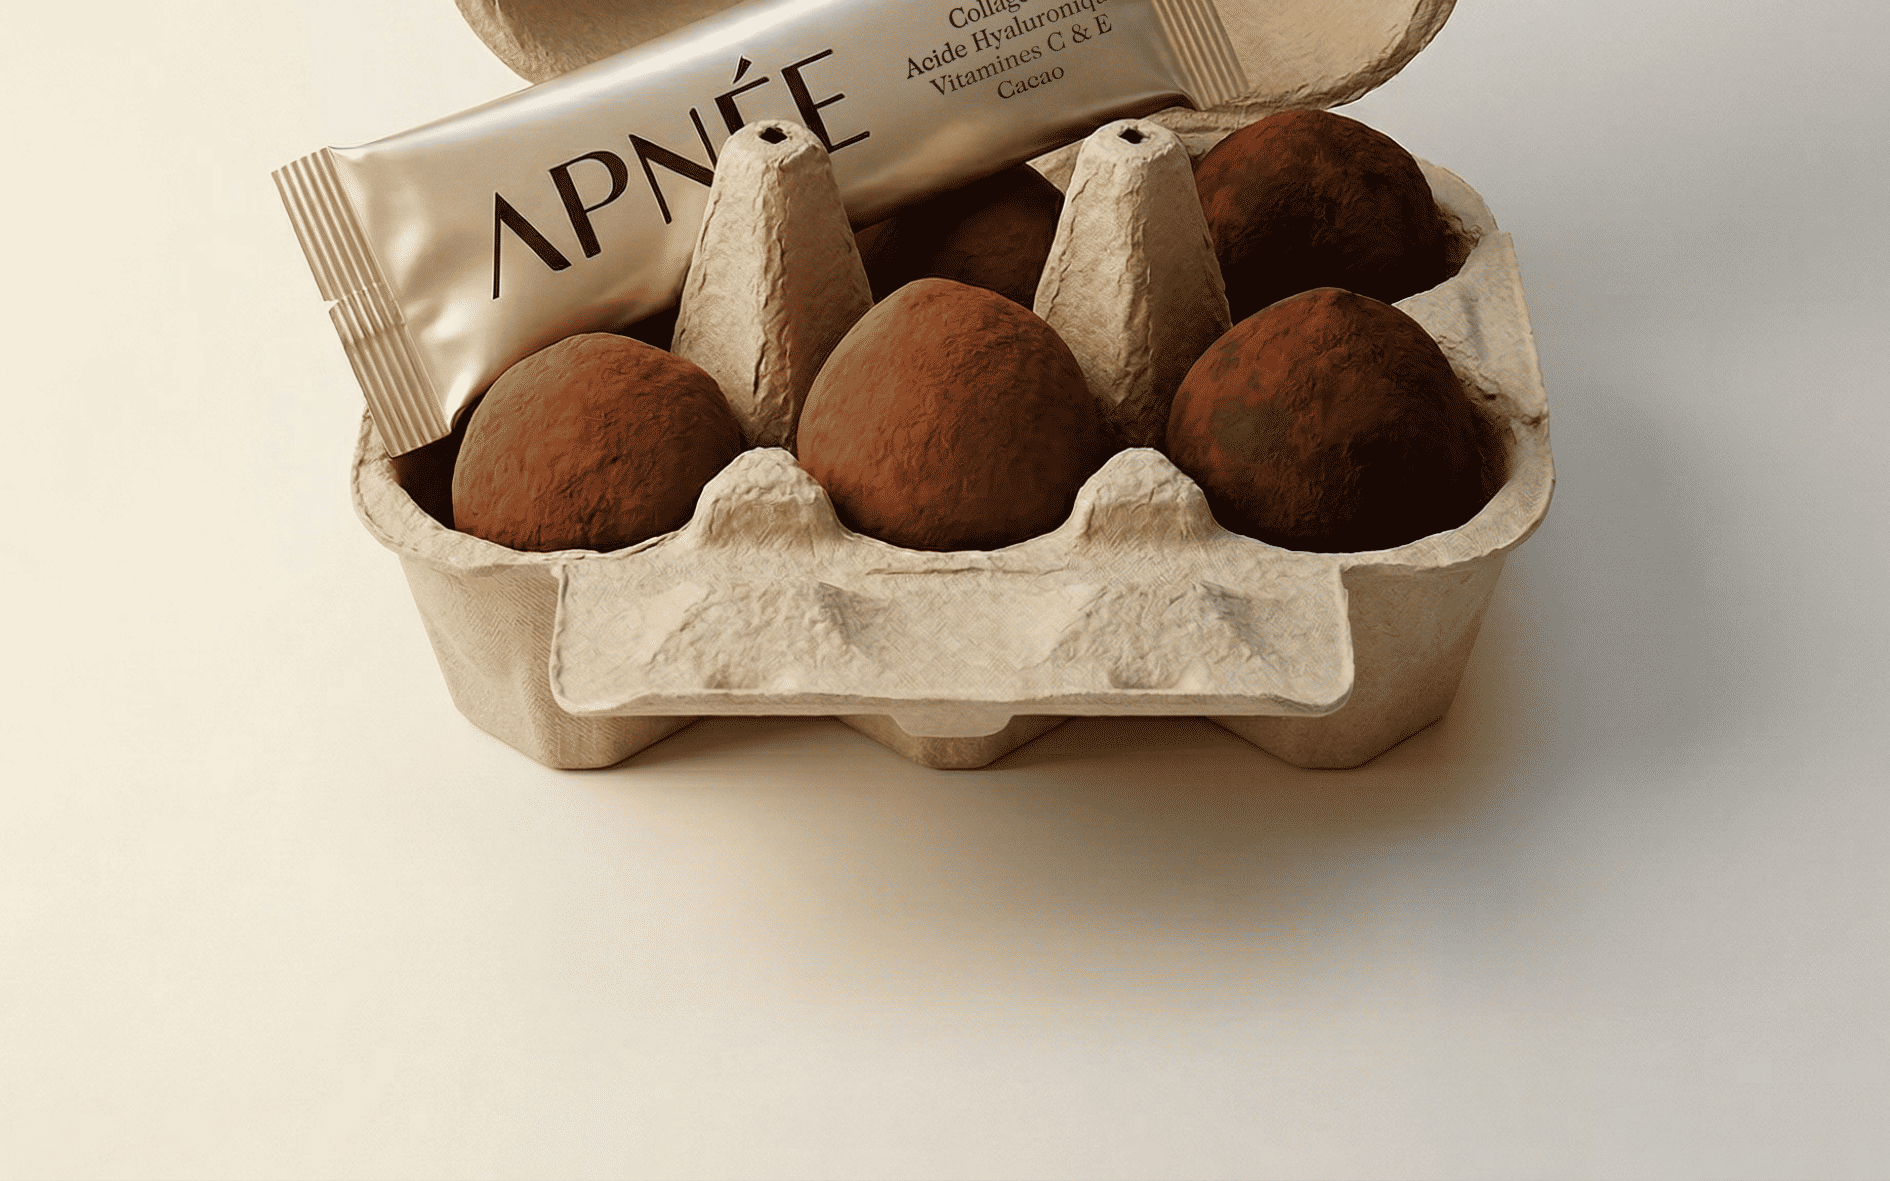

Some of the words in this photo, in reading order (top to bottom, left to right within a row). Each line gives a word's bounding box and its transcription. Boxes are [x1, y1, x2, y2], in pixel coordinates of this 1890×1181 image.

[906, 42, 967, 79] Acide
[929, 44, 1042, 96] Vitamines
[1047, 31, 1066, 53] C
[1072, 24, 1092, 44] &
[1097, 13, 1112, 35] E
[997, 66, 1065, 99] Cacao
